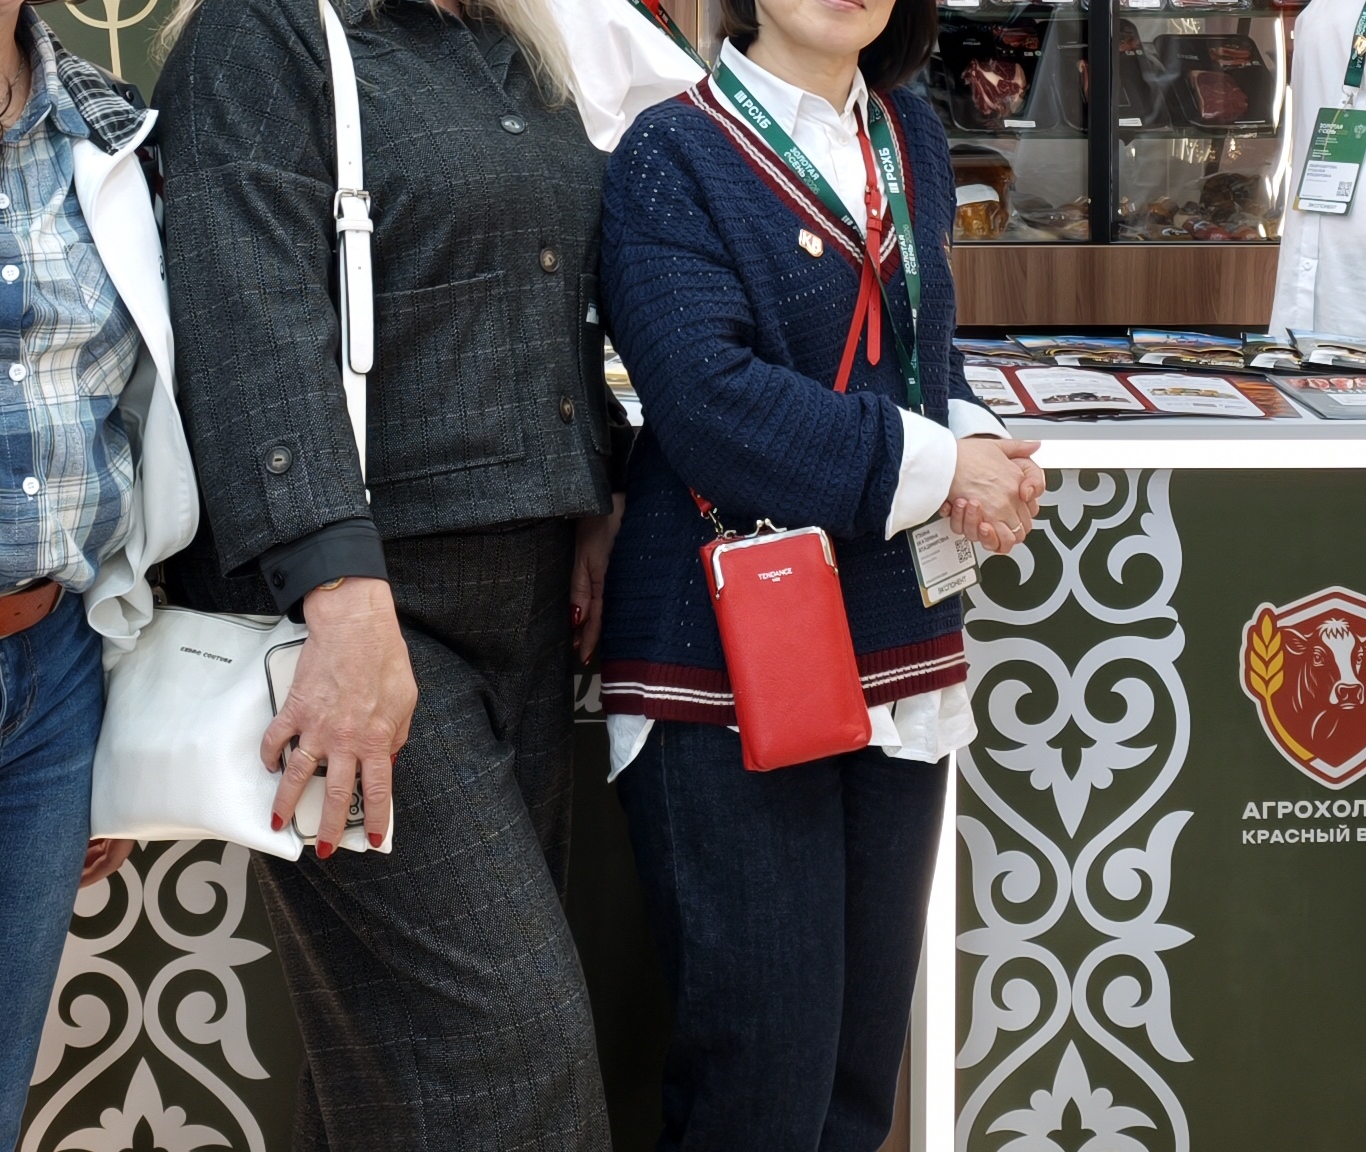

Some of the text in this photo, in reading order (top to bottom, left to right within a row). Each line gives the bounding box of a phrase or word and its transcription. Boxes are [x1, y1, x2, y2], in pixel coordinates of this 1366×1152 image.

[741, 98, 771, 129] РСХБ
[789, 147, 820, 180] ЗОЛОТАЯ
[879, 147, 894, 183] РСХБ
[1241, 824, 1350, 845] КРАСНЫЙ
